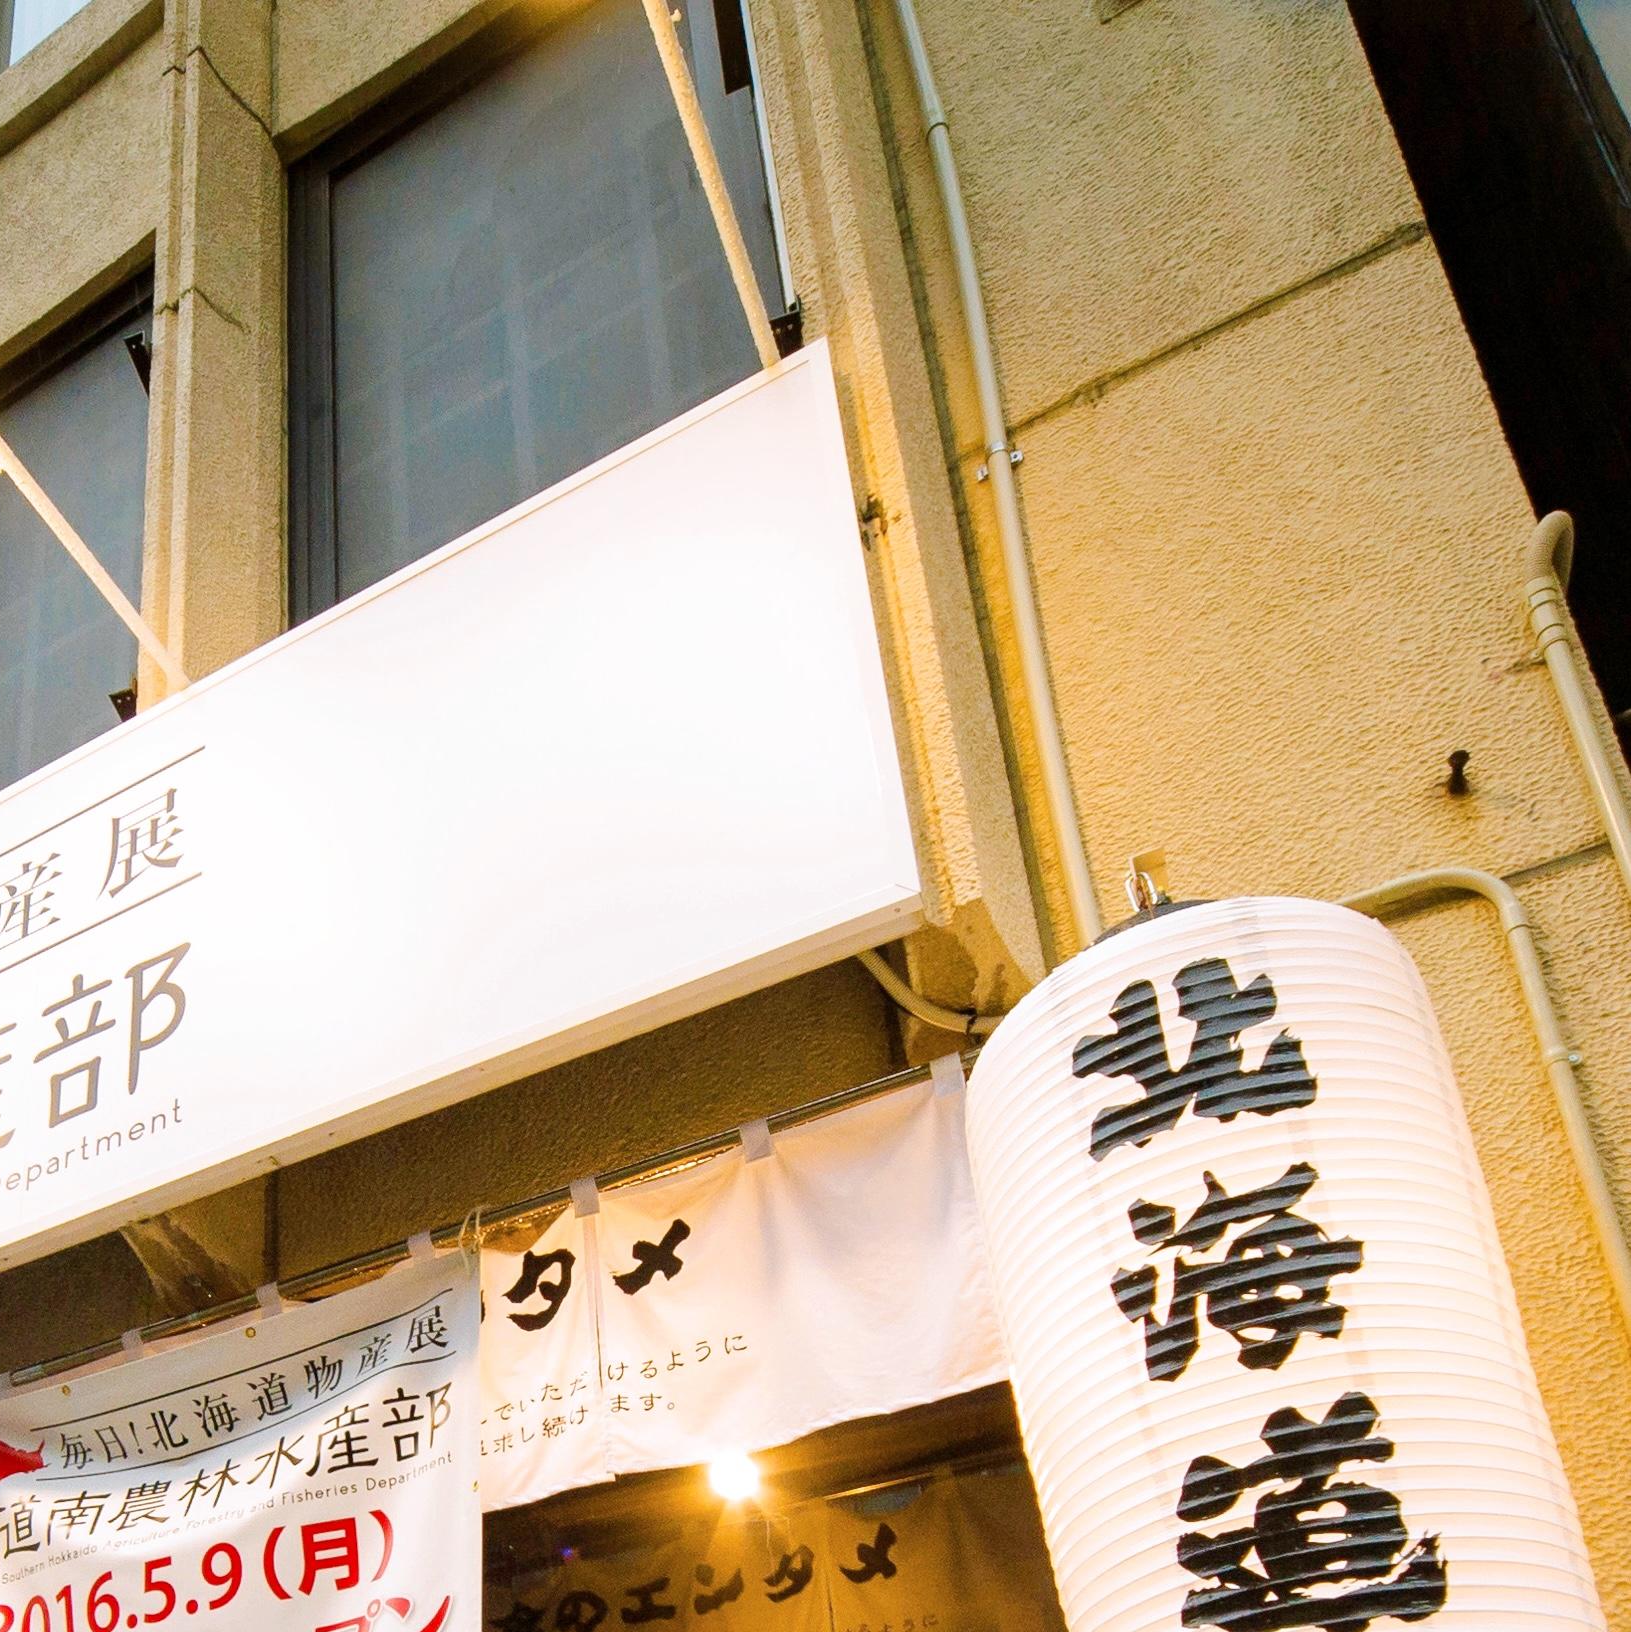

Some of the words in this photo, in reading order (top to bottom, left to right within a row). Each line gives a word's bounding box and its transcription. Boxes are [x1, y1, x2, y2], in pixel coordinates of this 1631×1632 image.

[480, 1218, 691, 1332] タメ
[281, 1483, 358, 1505] Fisheries
[365, 1451, 453, 1492] Department
